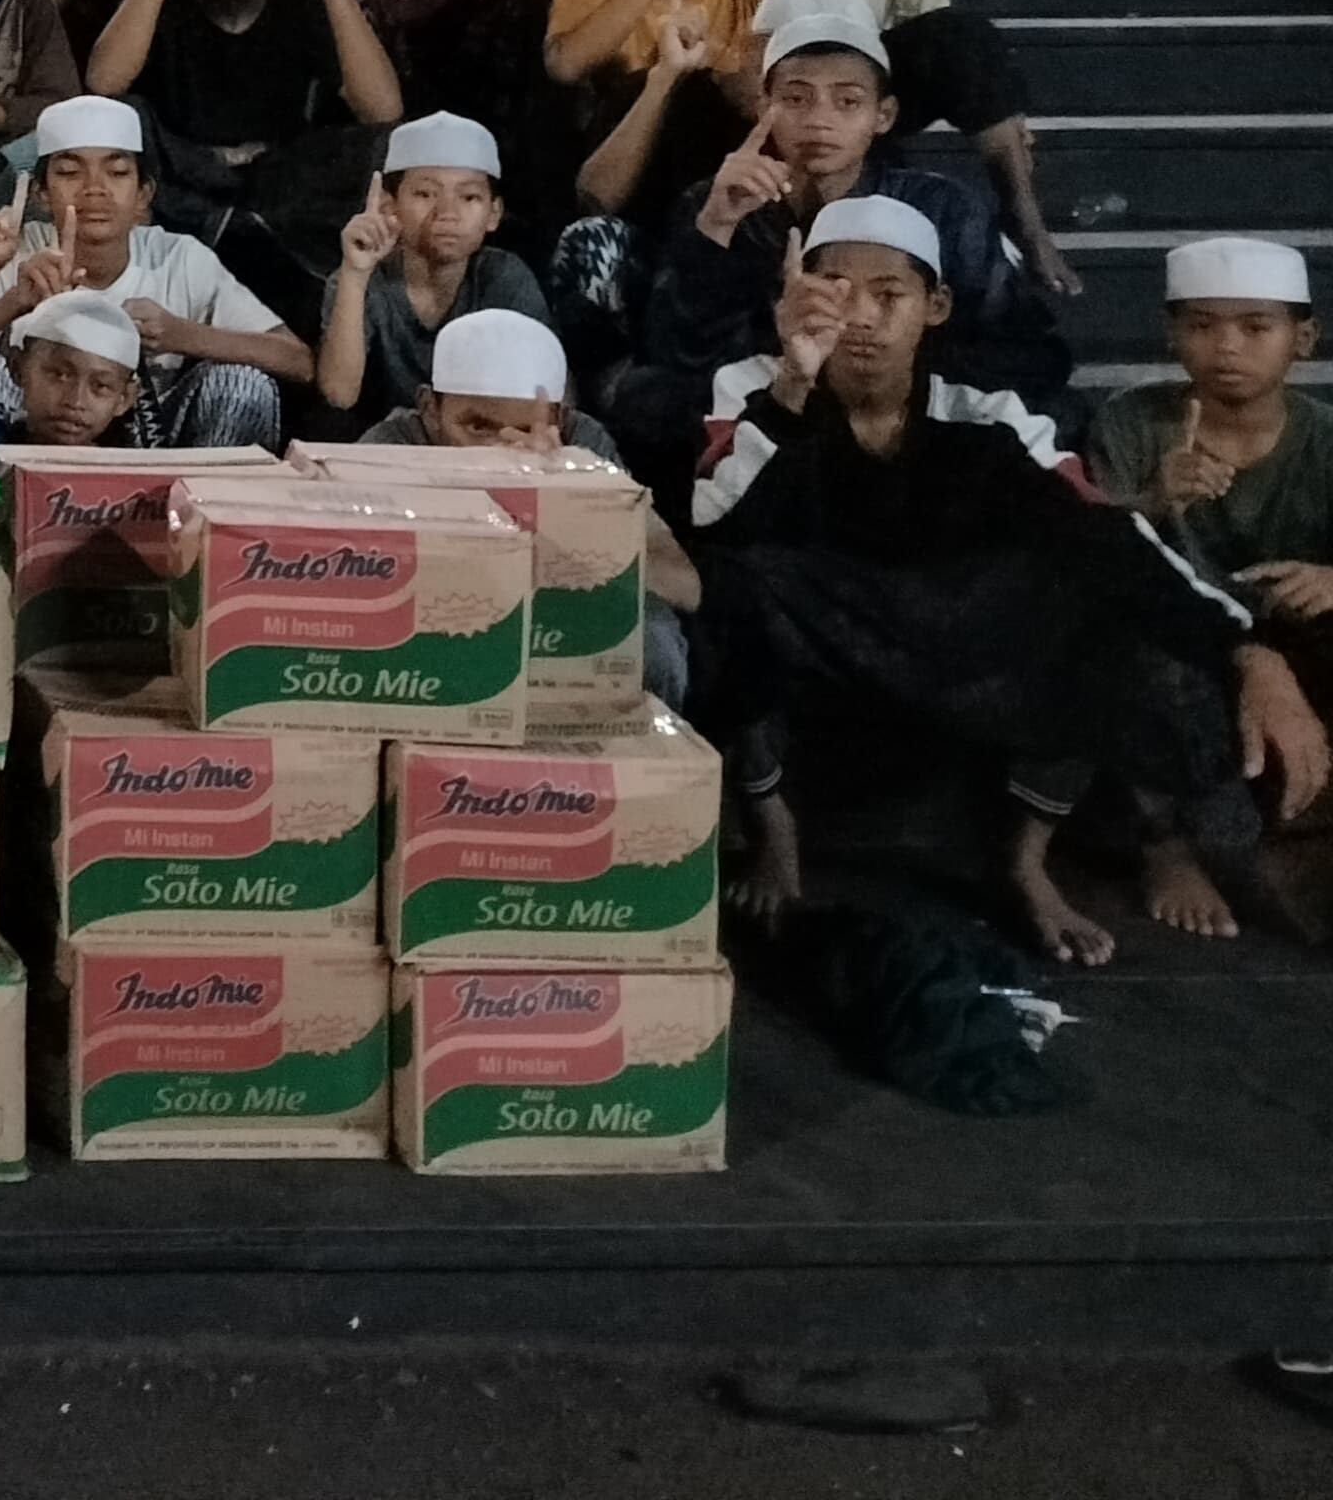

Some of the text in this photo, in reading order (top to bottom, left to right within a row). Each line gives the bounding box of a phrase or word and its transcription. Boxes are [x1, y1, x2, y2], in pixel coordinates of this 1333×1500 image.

[218, 539, 397, 590] Indomie
[263, 616, 355, 638] Mi Instan
[532, 623, 565, 652] ie
[306, 652, 341, 665] Rasa
[281, 664, 442, 700] Soto Mie
[81, 753, 254, 801] Indomie
[424, 776, 596, 821] Indomie
[125, 828, 214, 848] Mi Instan
[166, 862, 200, 875] Rasa
[460, 852, 552, 872] Mi Instan
[142, 875, 298, 905] Soto Mie
[475, 897, 634, 928] Soto Mie
[99, 972, 265, 1021] Indomie
[435, 978, 602, 1028] Indomie
[137, 1043, 225, 1063] Mi Instan
[478, 1056, 568, 1075] Mi Instan
[153, 1086, 308, 1113] Soto Mie
[497, 1103, 653, 1133] Soto Mie
